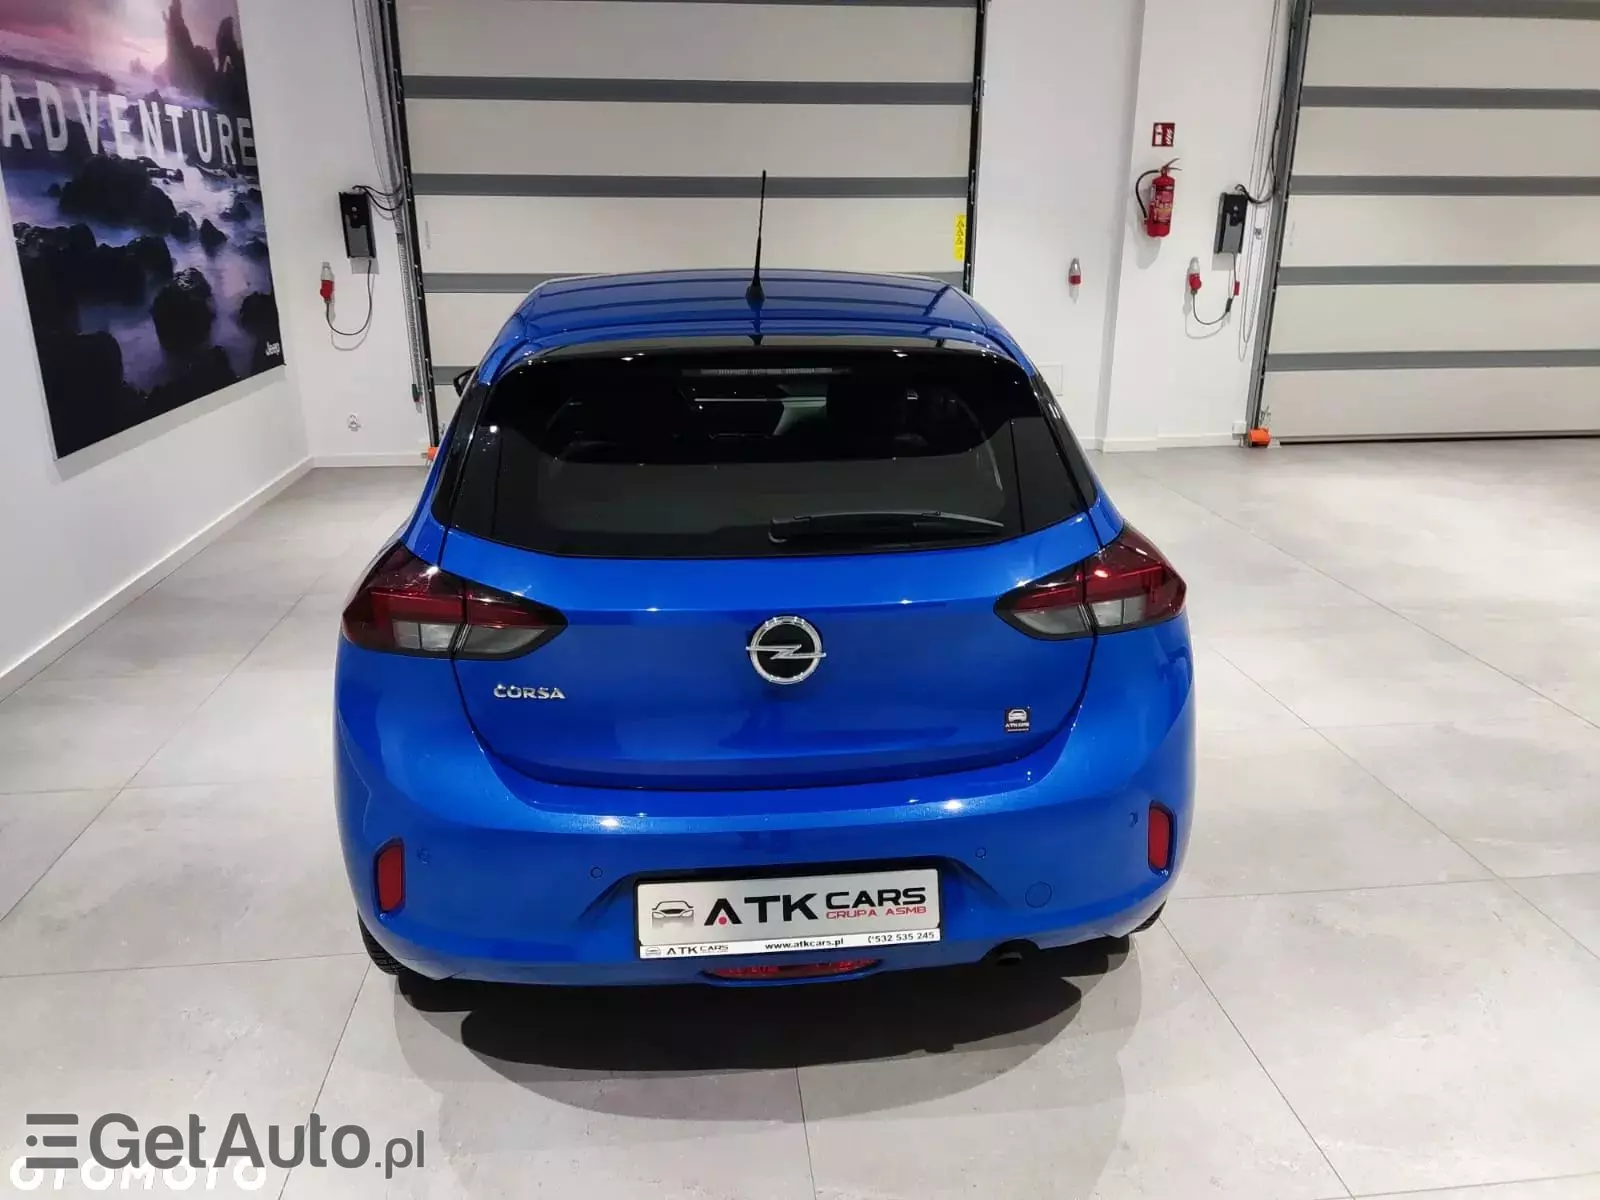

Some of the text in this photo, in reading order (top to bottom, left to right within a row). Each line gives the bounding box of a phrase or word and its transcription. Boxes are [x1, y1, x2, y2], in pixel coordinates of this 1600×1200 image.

[0, 73, 257, 167] ADVENTURE
[493, 684, 566, 699] CORSA
[704, 886, 926, 926] ATK CARS
[826, 906, 926, 919] GRUPA ASMB
[896, 933, 914, 941] 535
[916, 931, 935, 940] 245
[667, 946, 698, 956] ATK
[765, 937, 844, 951] www.atkcars.pl
